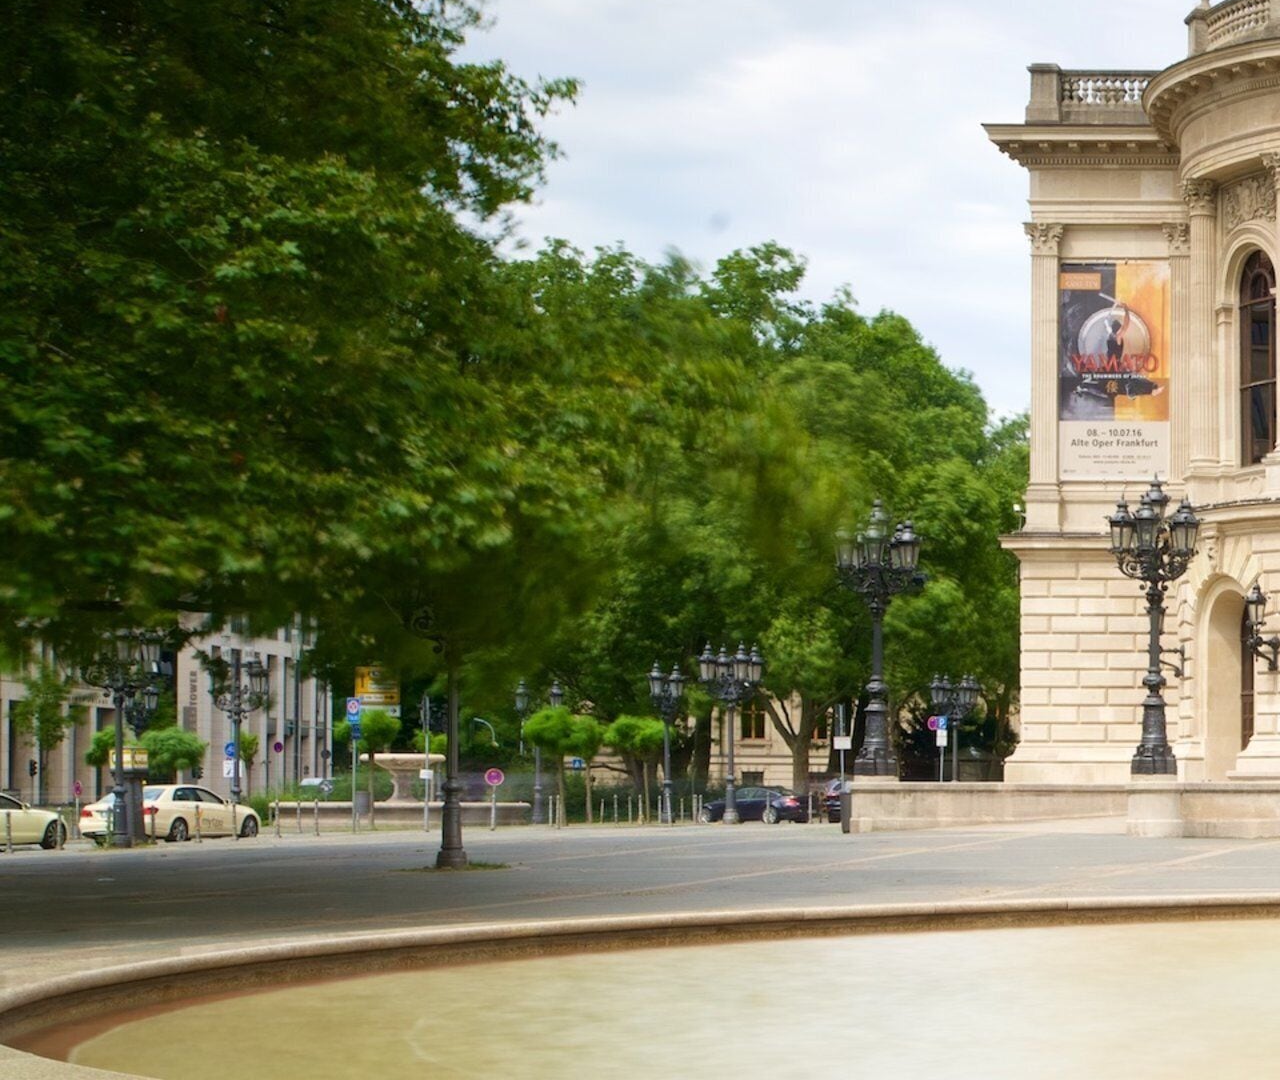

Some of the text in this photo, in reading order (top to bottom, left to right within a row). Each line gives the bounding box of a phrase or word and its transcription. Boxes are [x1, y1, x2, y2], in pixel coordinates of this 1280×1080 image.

[1072, 353, 1160, 373] YAMATO
[1109, 428, 1142, 437] 10.07.16
[1071, 439, 1158, 449] Alte Oper Frankfurt
